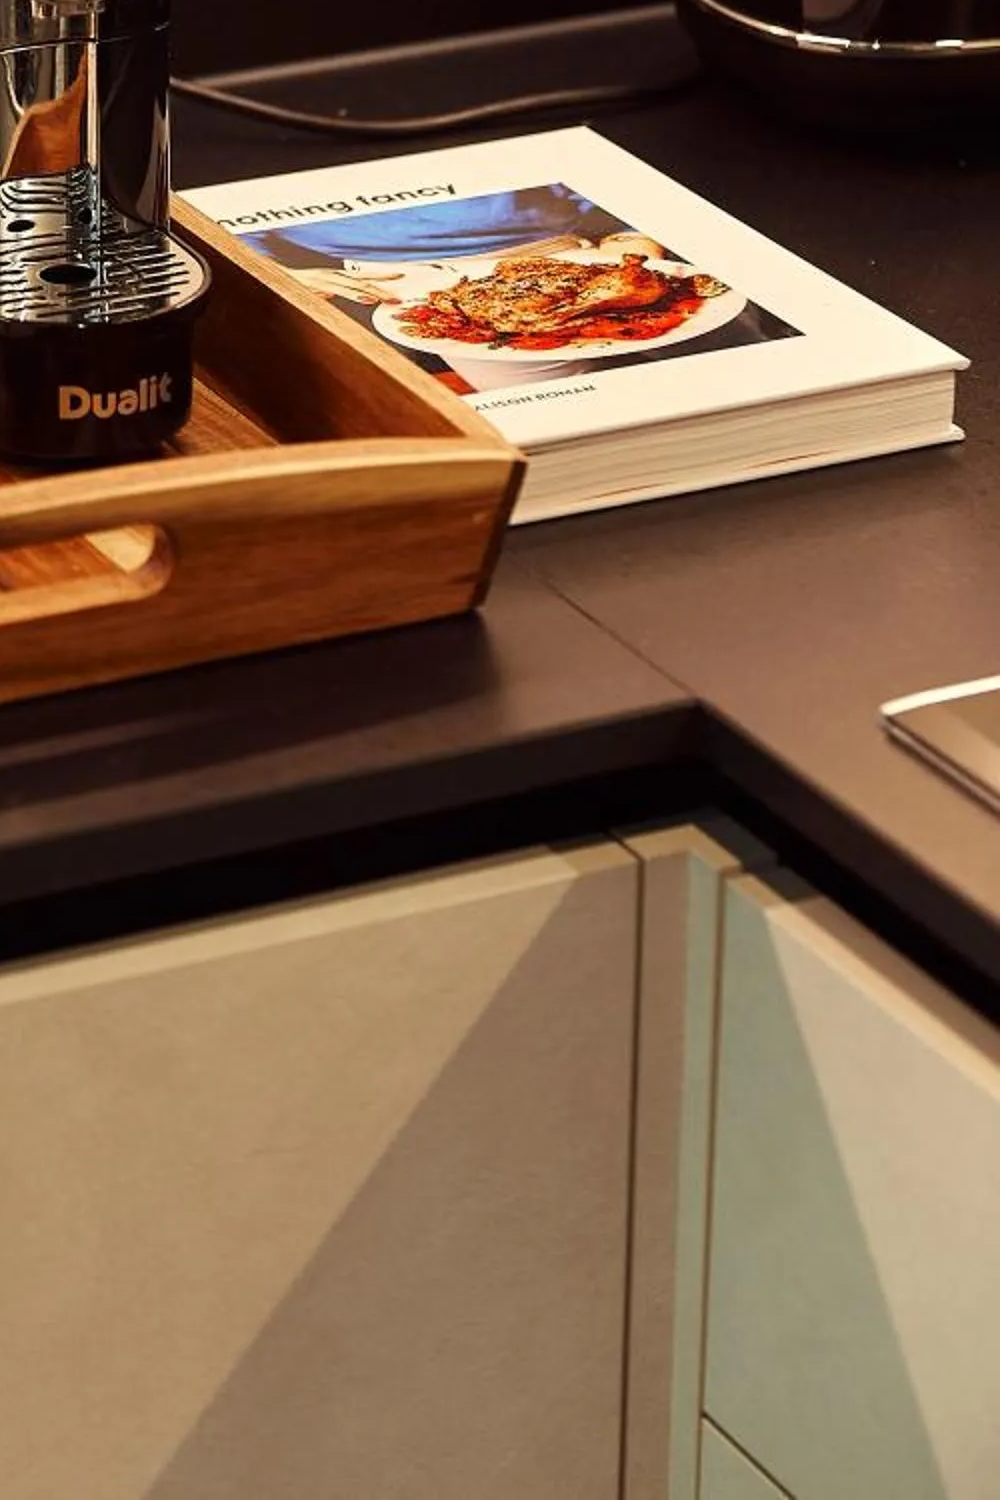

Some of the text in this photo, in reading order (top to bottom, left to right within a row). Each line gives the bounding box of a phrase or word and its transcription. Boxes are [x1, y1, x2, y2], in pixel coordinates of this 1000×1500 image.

[217, 183, 457, 228] nothing fancy
[58, 372, 173, 421] Dualit
[535, 385, 596, 401] ROMAN
